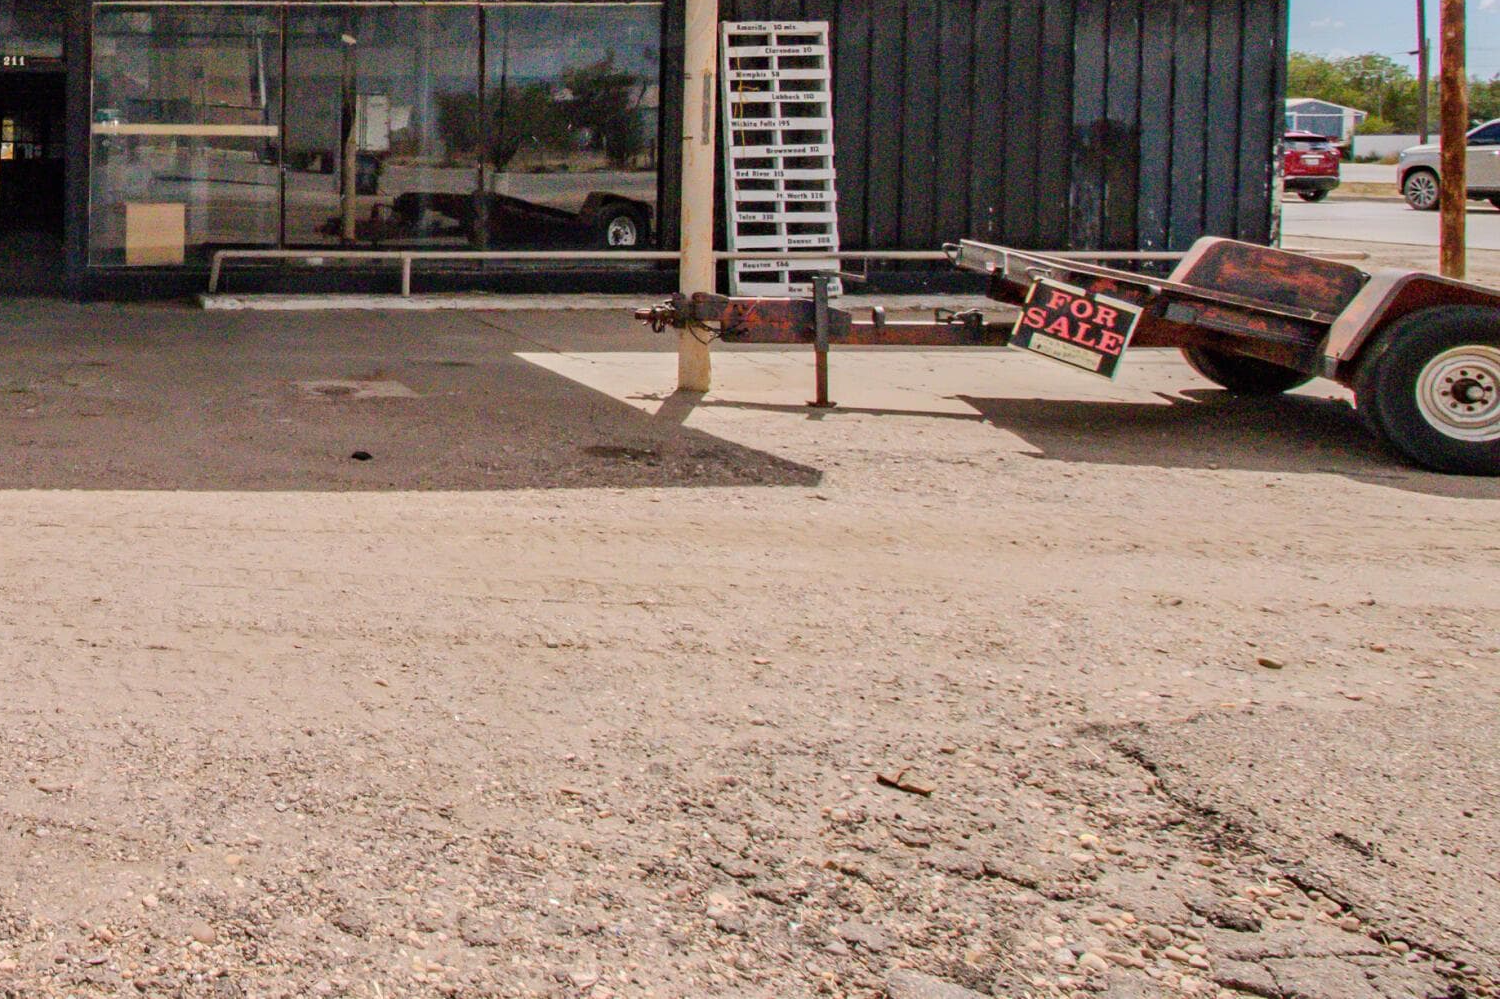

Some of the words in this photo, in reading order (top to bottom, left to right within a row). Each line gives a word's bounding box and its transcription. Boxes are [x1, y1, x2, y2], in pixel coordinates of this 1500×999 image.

[764, 46, 800, 54] Clarendon
[2, 55, 26, 66] 211
[735, 70, 766, 79] Memphis
[1045, 290, 1119, 328] FOR
[1022, 306, 1125, 357] SALE
